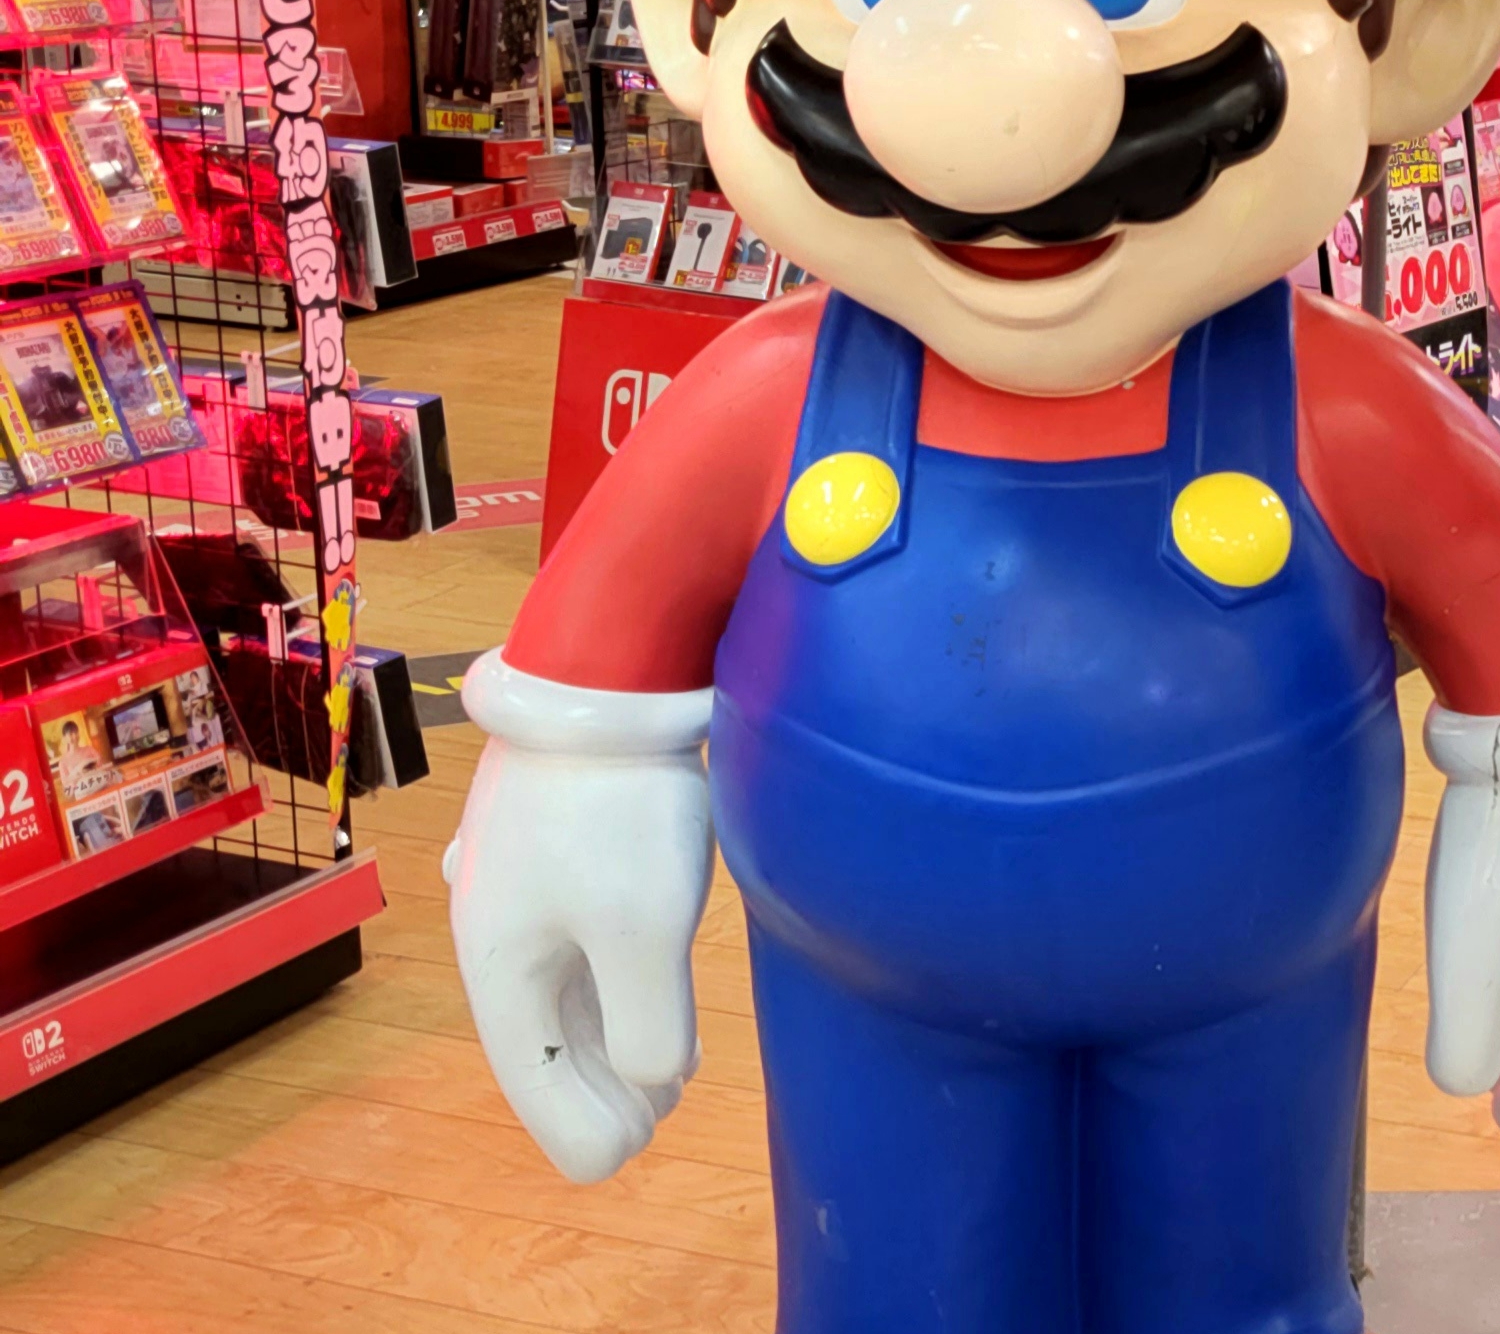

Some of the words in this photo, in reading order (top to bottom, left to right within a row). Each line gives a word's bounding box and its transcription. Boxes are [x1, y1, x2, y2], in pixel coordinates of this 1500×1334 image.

[1387, 163, 1442, 190] 出してきた!
[3, 769, 35, 816] 2
[28, 1052, 66, 1077] SWITCH
